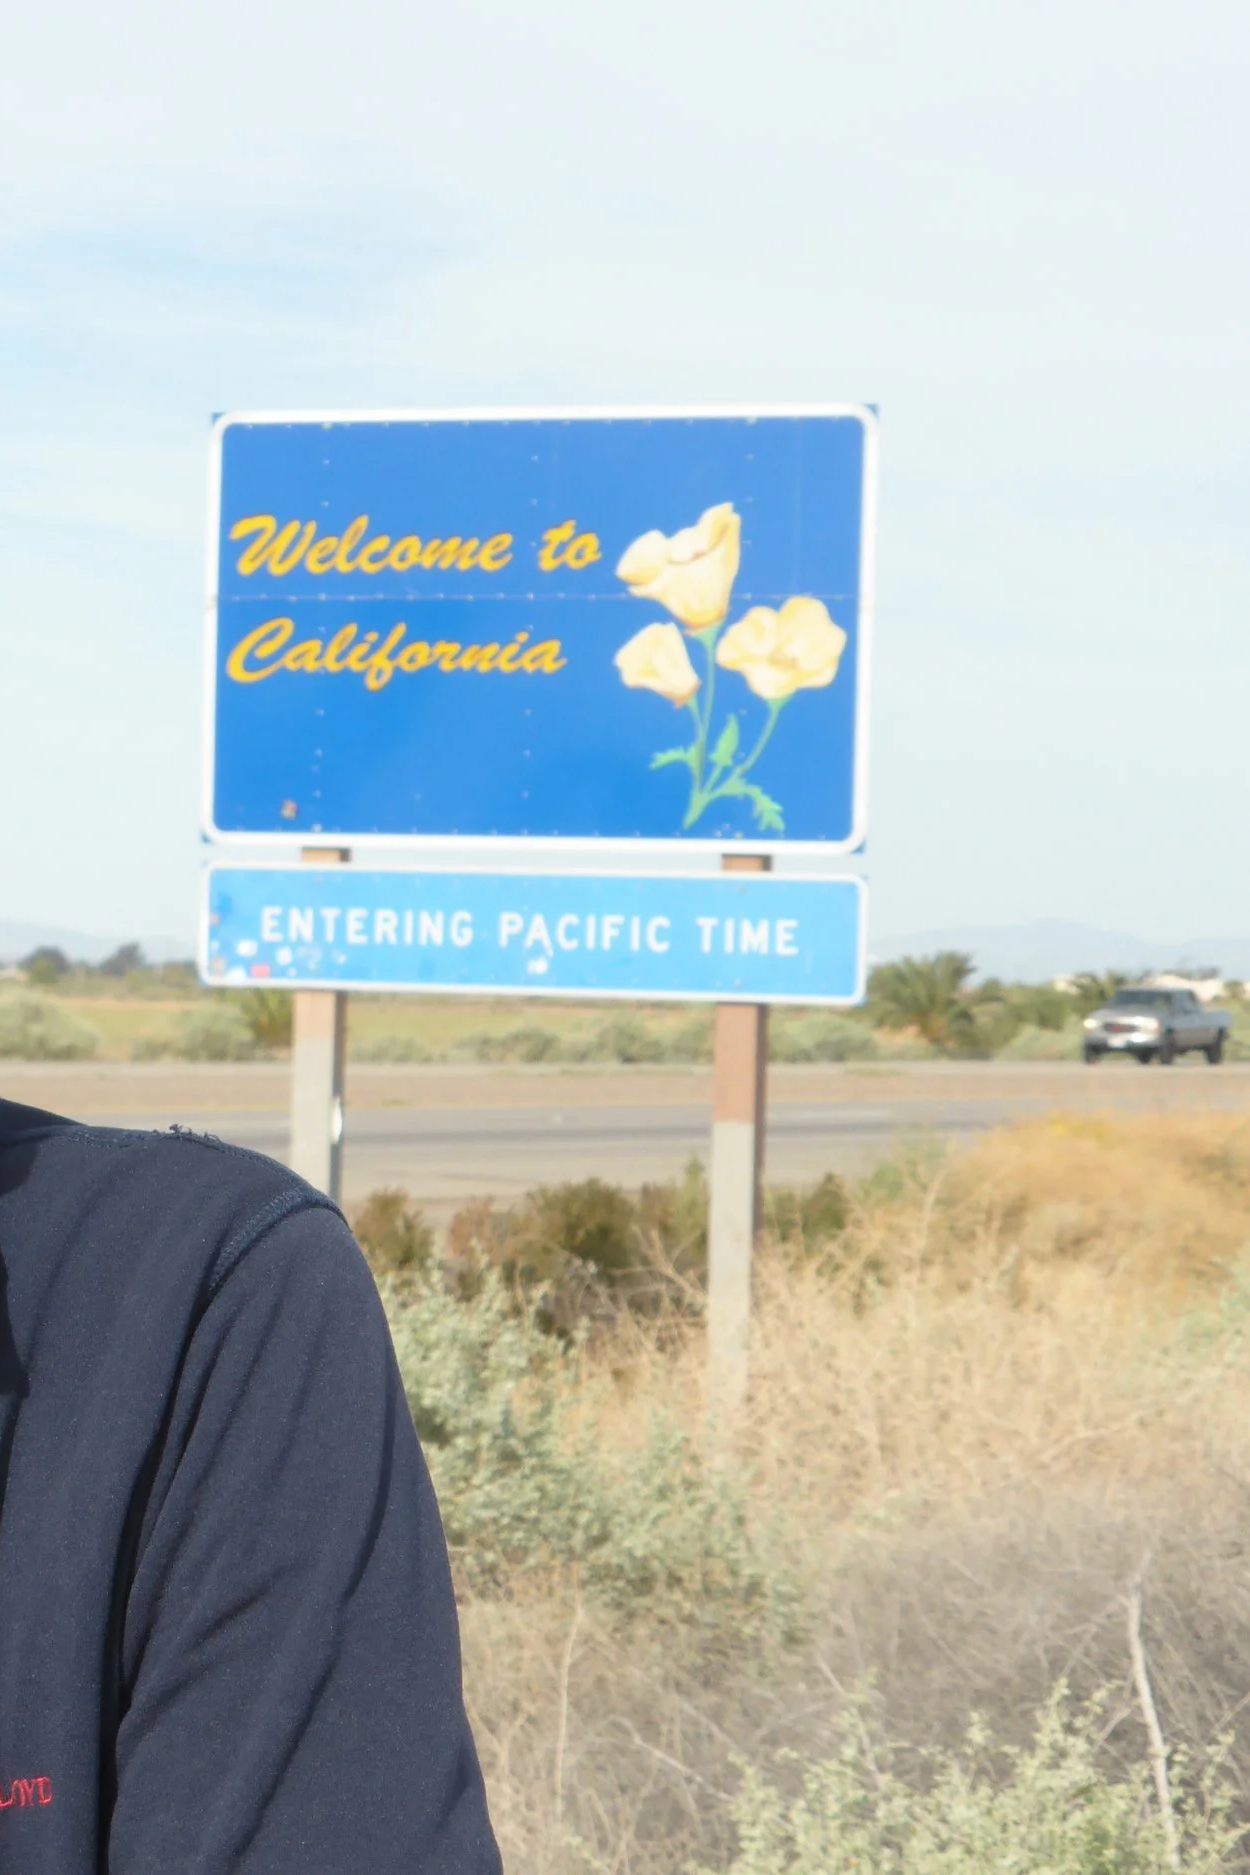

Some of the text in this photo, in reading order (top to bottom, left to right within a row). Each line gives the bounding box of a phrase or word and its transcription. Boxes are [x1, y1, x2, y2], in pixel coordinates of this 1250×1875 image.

[229, 513, 602, 577] Welcome to
[226, 616, 568, 692] California
[260, 905, 800, 956] ENTERING PACIFIC TIME
